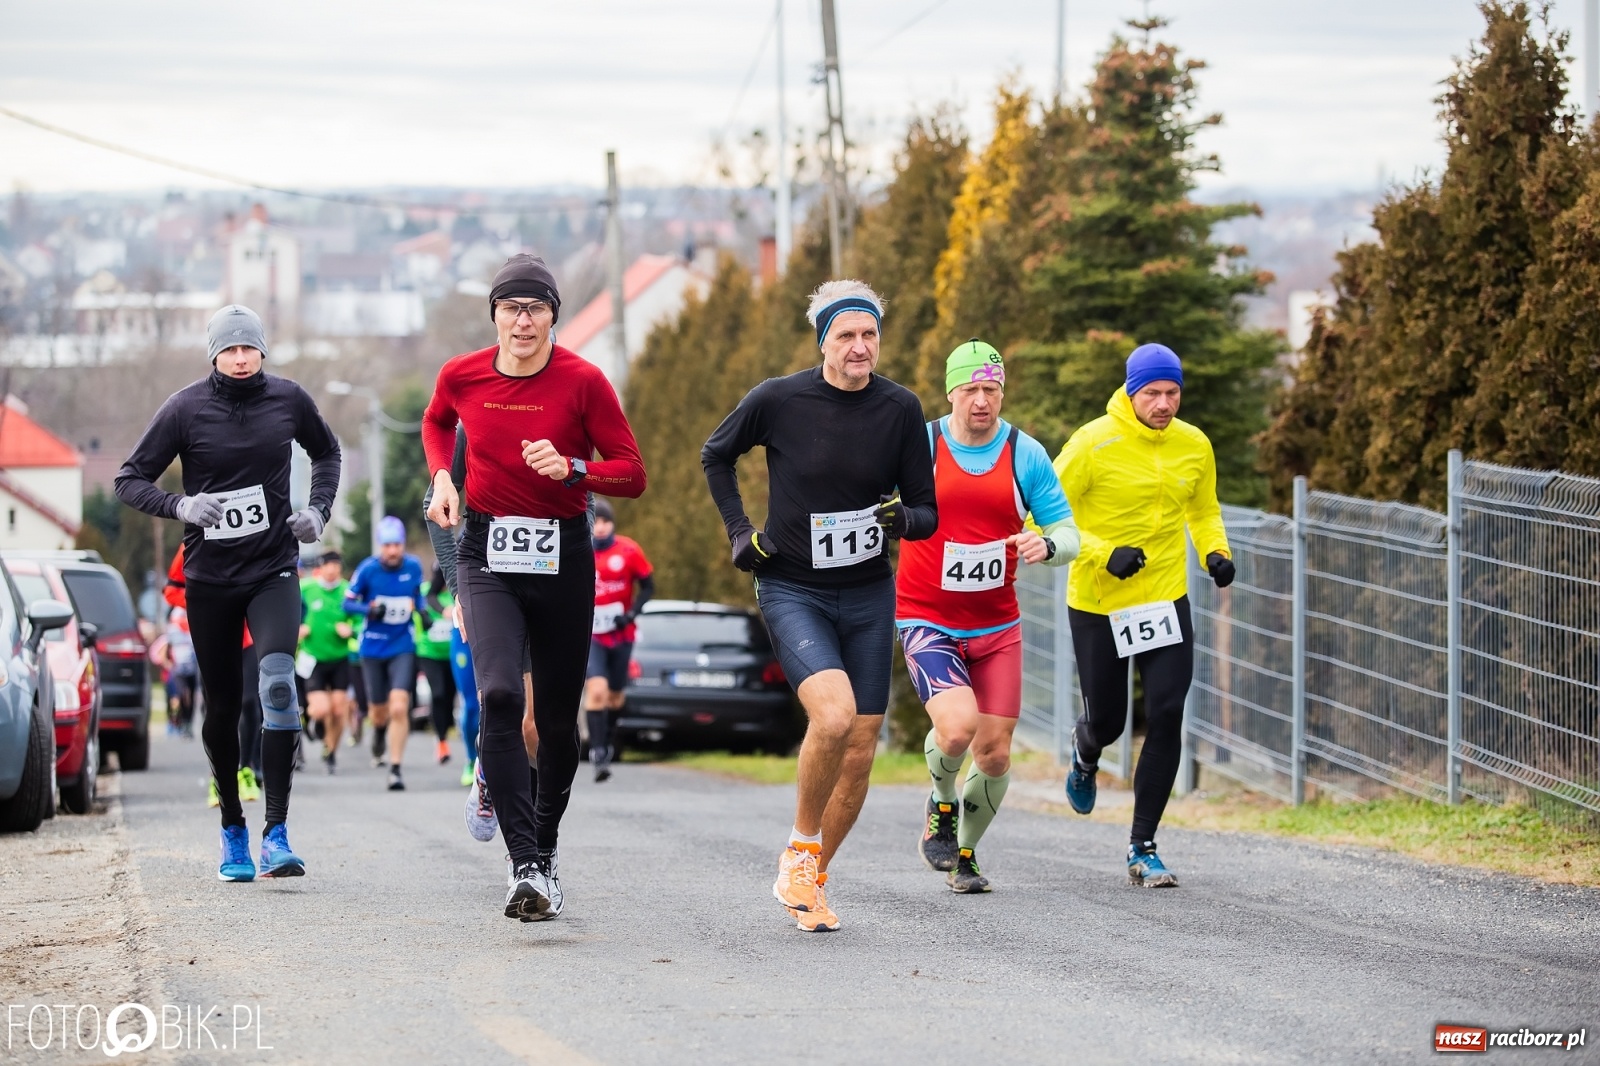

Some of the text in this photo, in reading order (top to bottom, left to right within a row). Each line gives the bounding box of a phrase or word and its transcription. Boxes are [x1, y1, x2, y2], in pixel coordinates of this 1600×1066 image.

[483, 402, 544, 411] BRUBECK
[585, 474, 632, 483] BRUBECK
[214, 504, 264, 530] 03
[492, 526, 555, 554] 258
[818, 526, 880, 558] 113
[946, 558, 1003, 583] 440
[1119, 615, 1173, 646] 151
